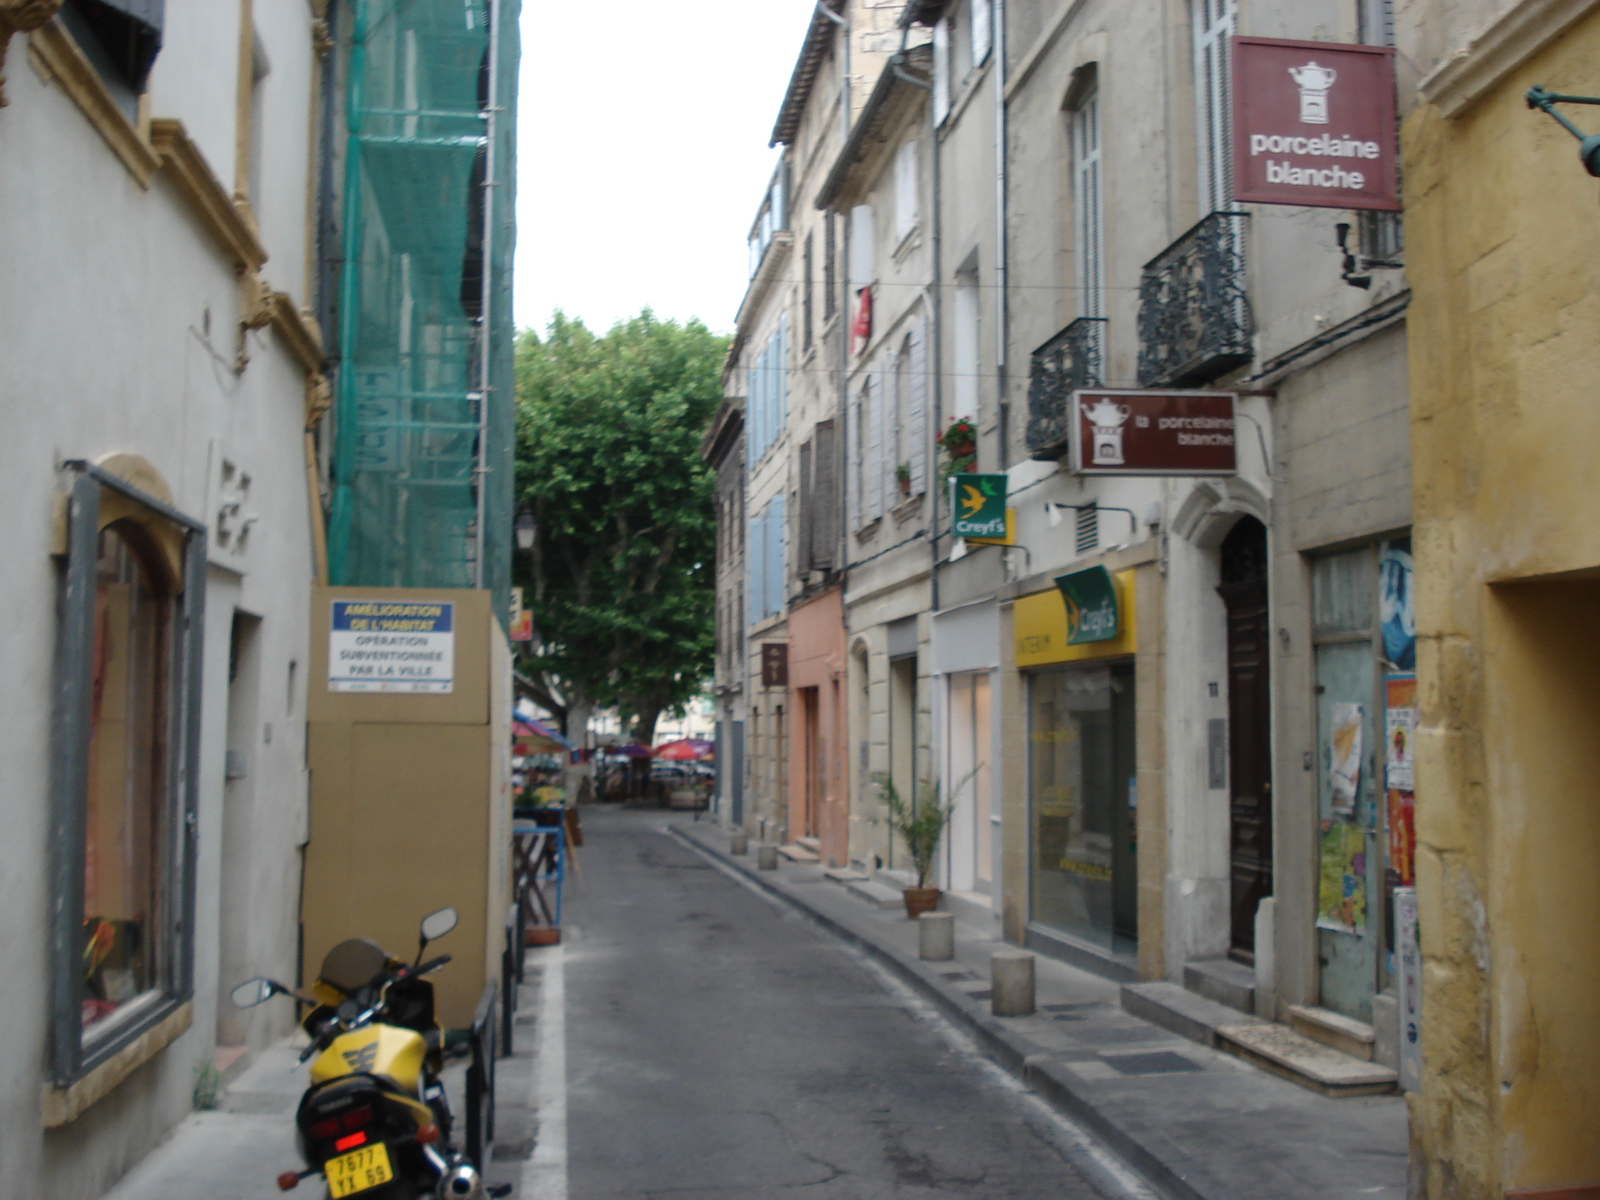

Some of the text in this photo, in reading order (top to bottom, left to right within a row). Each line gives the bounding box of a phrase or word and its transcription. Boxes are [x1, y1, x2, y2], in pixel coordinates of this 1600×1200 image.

[1250, 133, 1380, 159] porcelaine
[1265, 159, 1366, 190] blanche
[350, 618, 369, 630] DE
[349, 666, 432, 676] PAR LA VILLE
[336, 1148, 374, 1176] 7677
